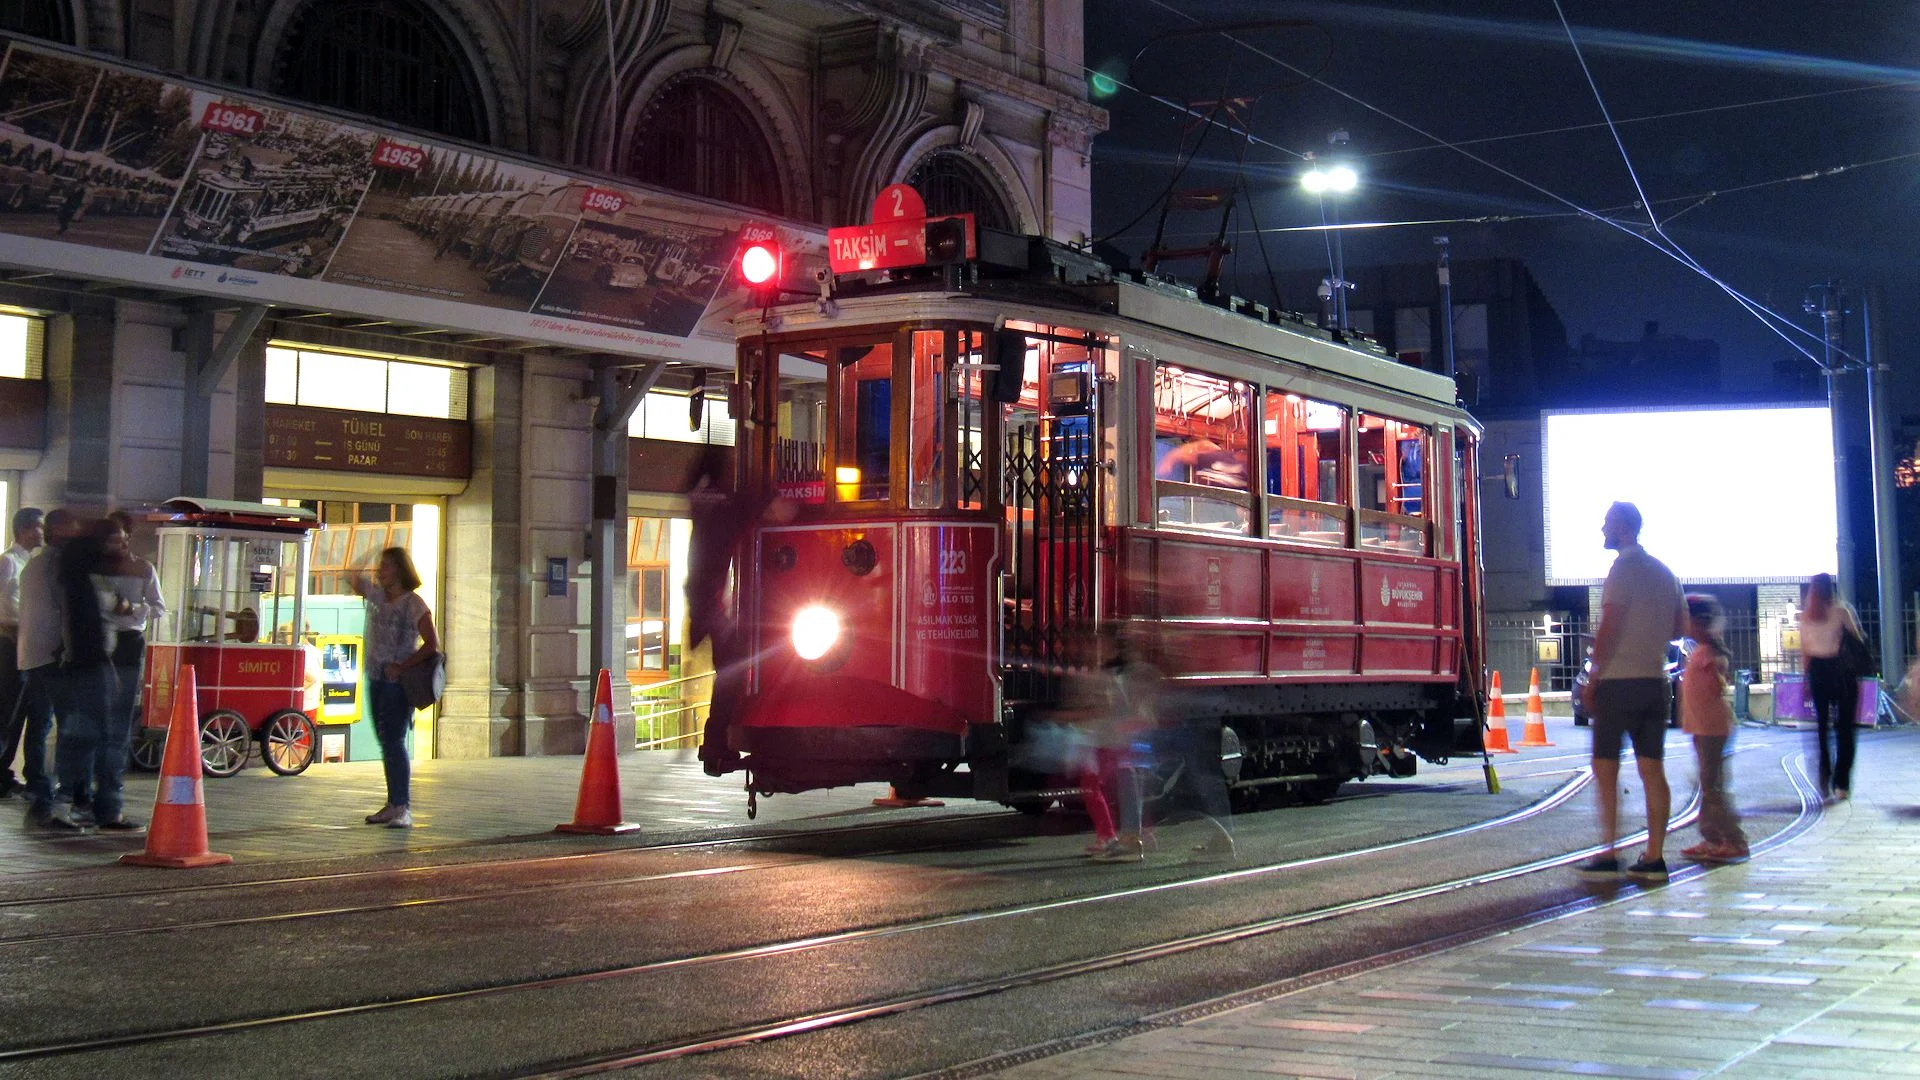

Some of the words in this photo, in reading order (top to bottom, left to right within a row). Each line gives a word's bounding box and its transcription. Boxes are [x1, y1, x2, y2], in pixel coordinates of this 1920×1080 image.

[208, 109, 256, 132] 1961
[379, 146, 421, 168] 1962
[586, 192, 621, 211] 1966
[892, 188, 904, 217] 2
[743, 227, 773, 242] 1968
[834, 229, 887, 260] TAKSİM
[342, 417, 386, 437] TÜNEL
[355, 439, 380, 452] GÜNÜ
[348, 454, 377, 466] PAZAR
[940, 550, 966, 574] 223
[940, 595, 958, 603] ALO
[960, 595, 975, 603] 153
[918, 615, 953, 625] ASILMAK
[955, 615, 977, 625] YASAK
[916, 630, 926, 640] VE
[928, 627, 979, 640] TEHLİKELİDİR
[238, 659, 281, 675] SİMİTÇİ
